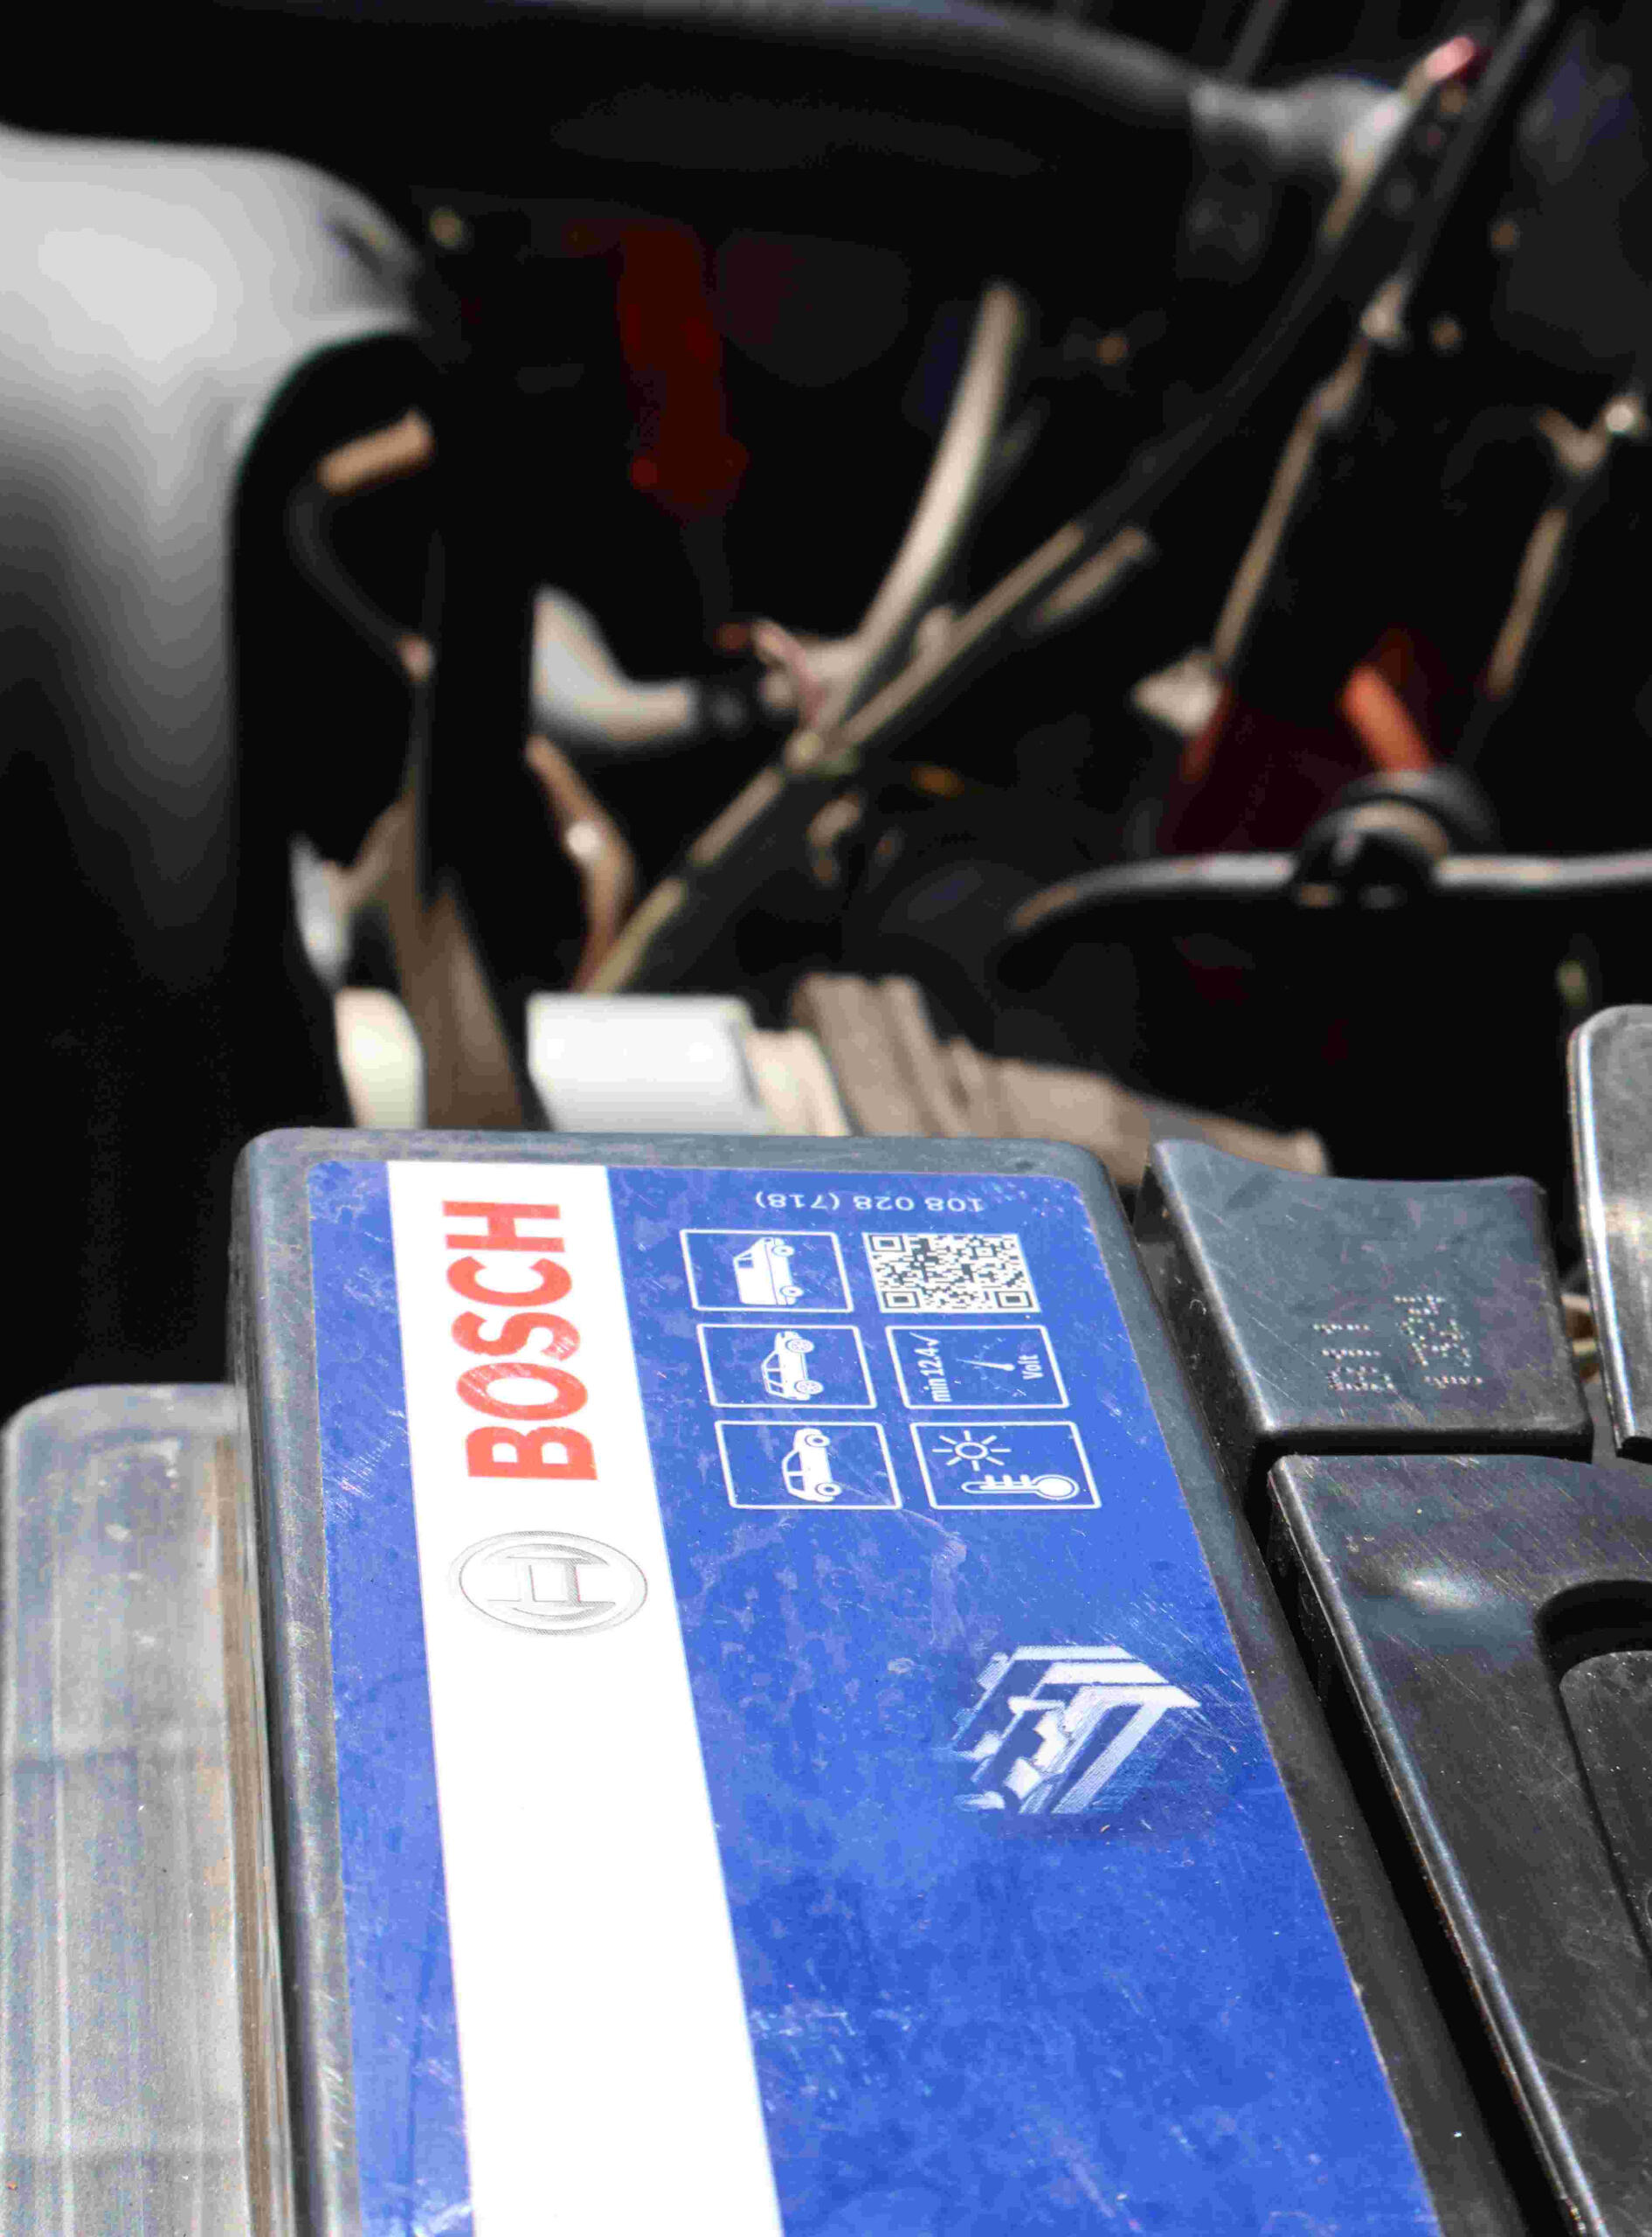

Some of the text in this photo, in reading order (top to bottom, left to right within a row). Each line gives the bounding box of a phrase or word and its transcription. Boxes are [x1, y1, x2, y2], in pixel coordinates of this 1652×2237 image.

[755, 1190, 985, 1213] 108 028 (718)
[442, 1201, 598, 1480] BOSCH
[1017, 1354, 1045, 1381] Volt
[923, 1378, 952, 1402] min
